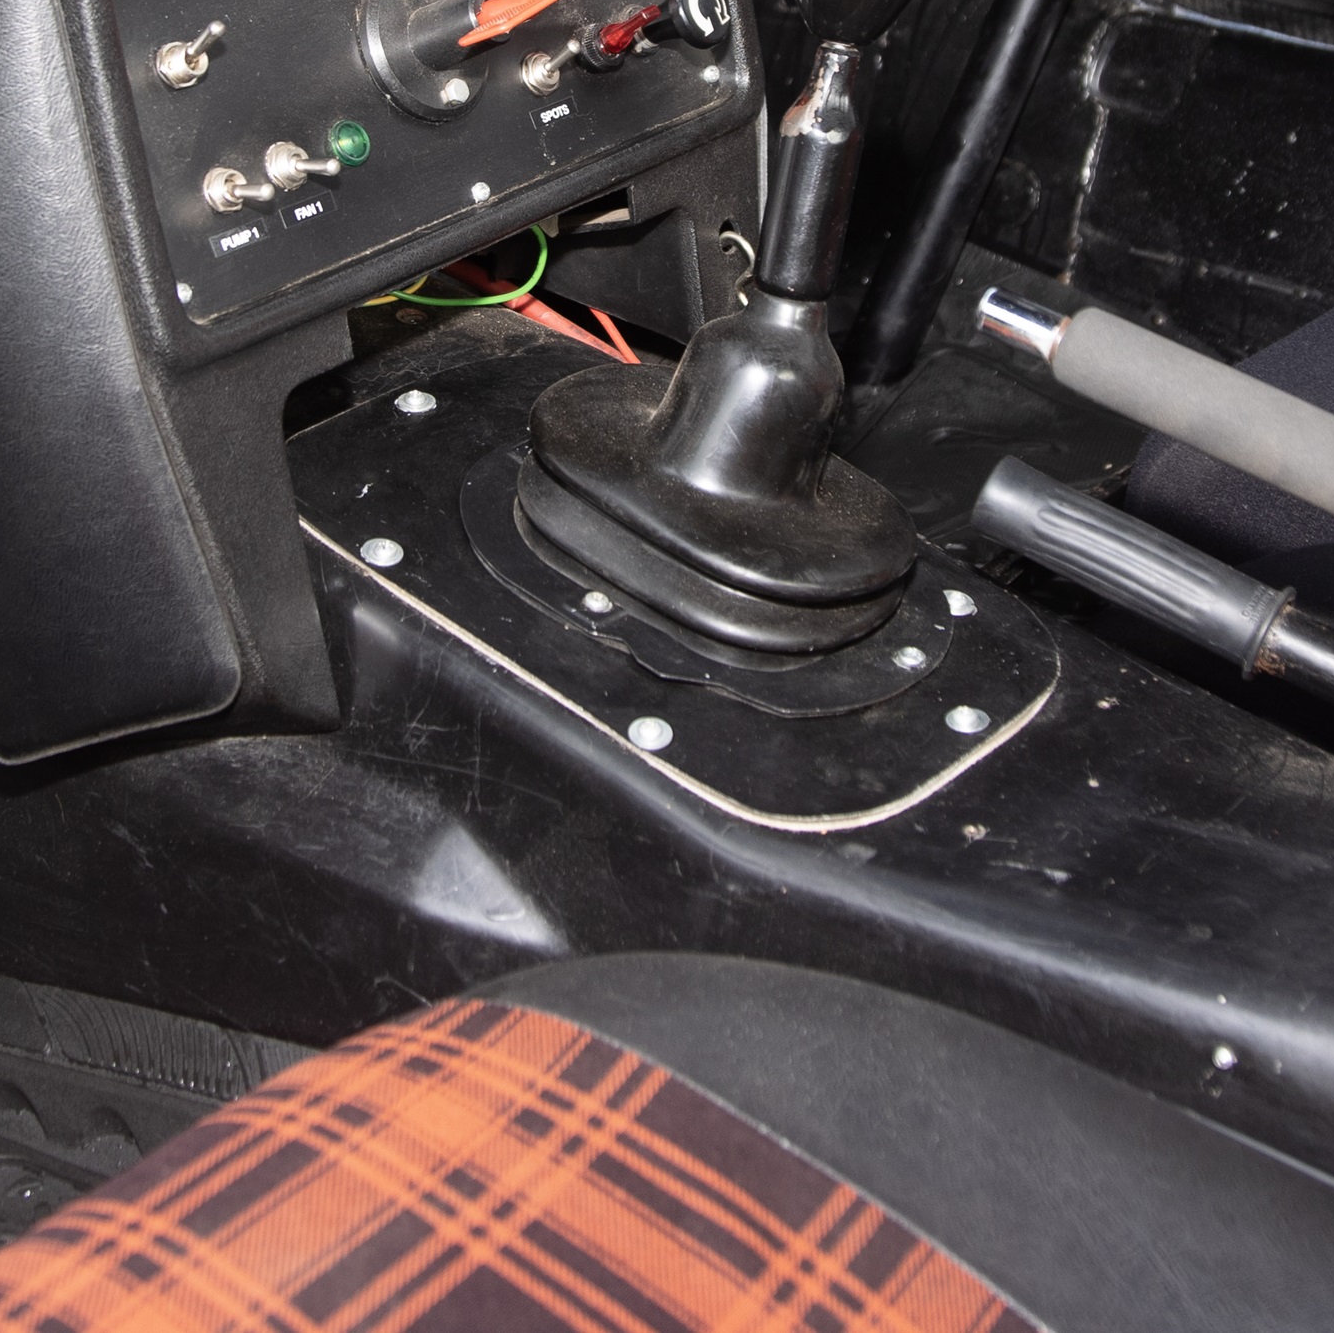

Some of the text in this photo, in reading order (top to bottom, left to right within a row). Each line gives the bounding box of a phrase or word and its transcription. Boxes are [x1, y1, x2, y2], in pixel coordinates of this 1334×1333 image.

[540, 103, 570, 124] SPOTS
[294, 200, 324, 221] FAN 1
[220, 226, 260, 252] PUMP 1
